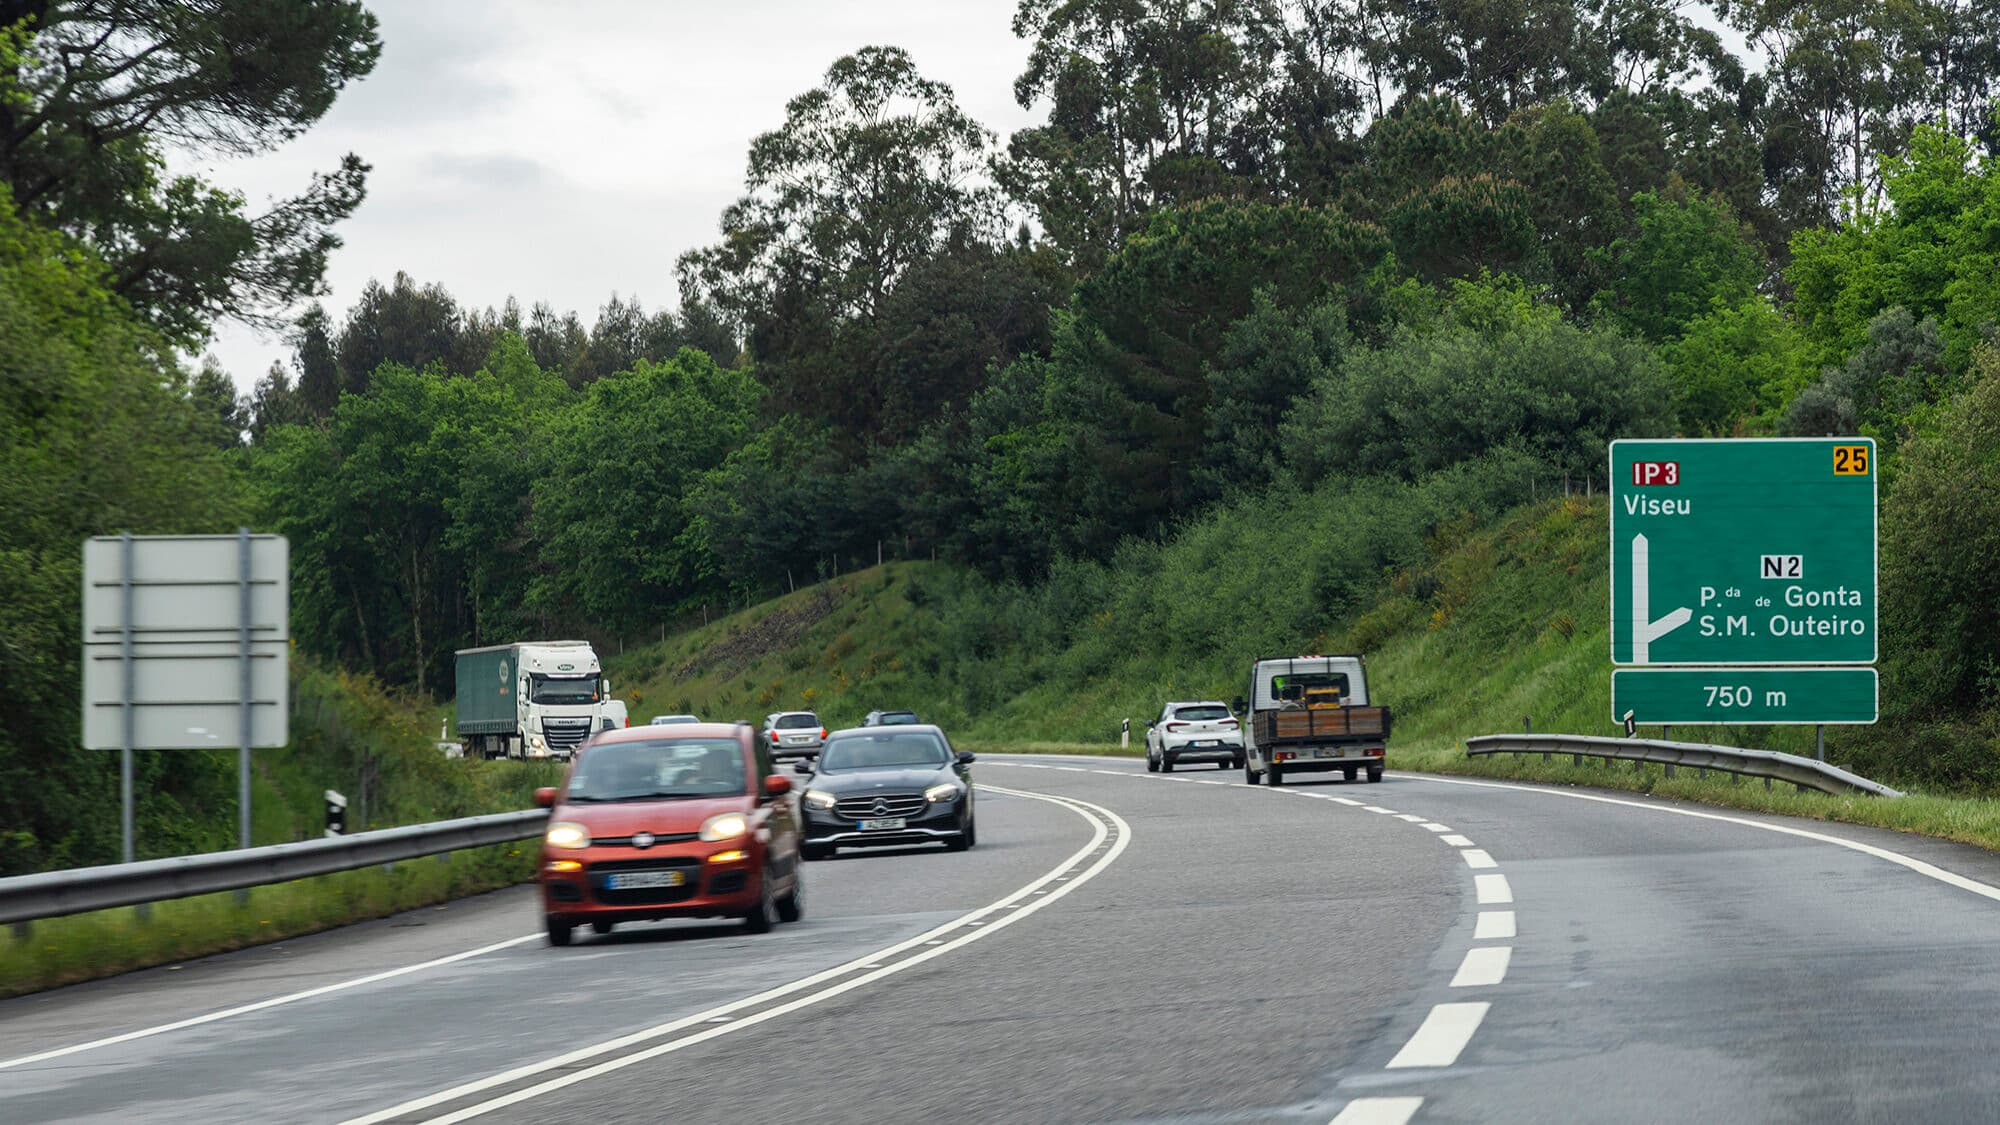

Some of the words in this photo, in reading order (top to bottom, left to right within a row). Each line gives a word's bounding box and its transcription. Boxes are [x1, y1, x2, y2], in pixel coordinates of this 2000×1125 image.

[1835, 448, 1866, 473] 25
[1623, 494, 1691, 516] Viseu
[1755, 596, 1771, 607] de
[1784, 585, 1862, 607] Gonta
[1699, 615, 1756, 637] S.M.
[1769, 614, 1866, 637] Outeiro
[1703, 685, 1753, 707] 750
[1765, 690, 1787, 707] m
